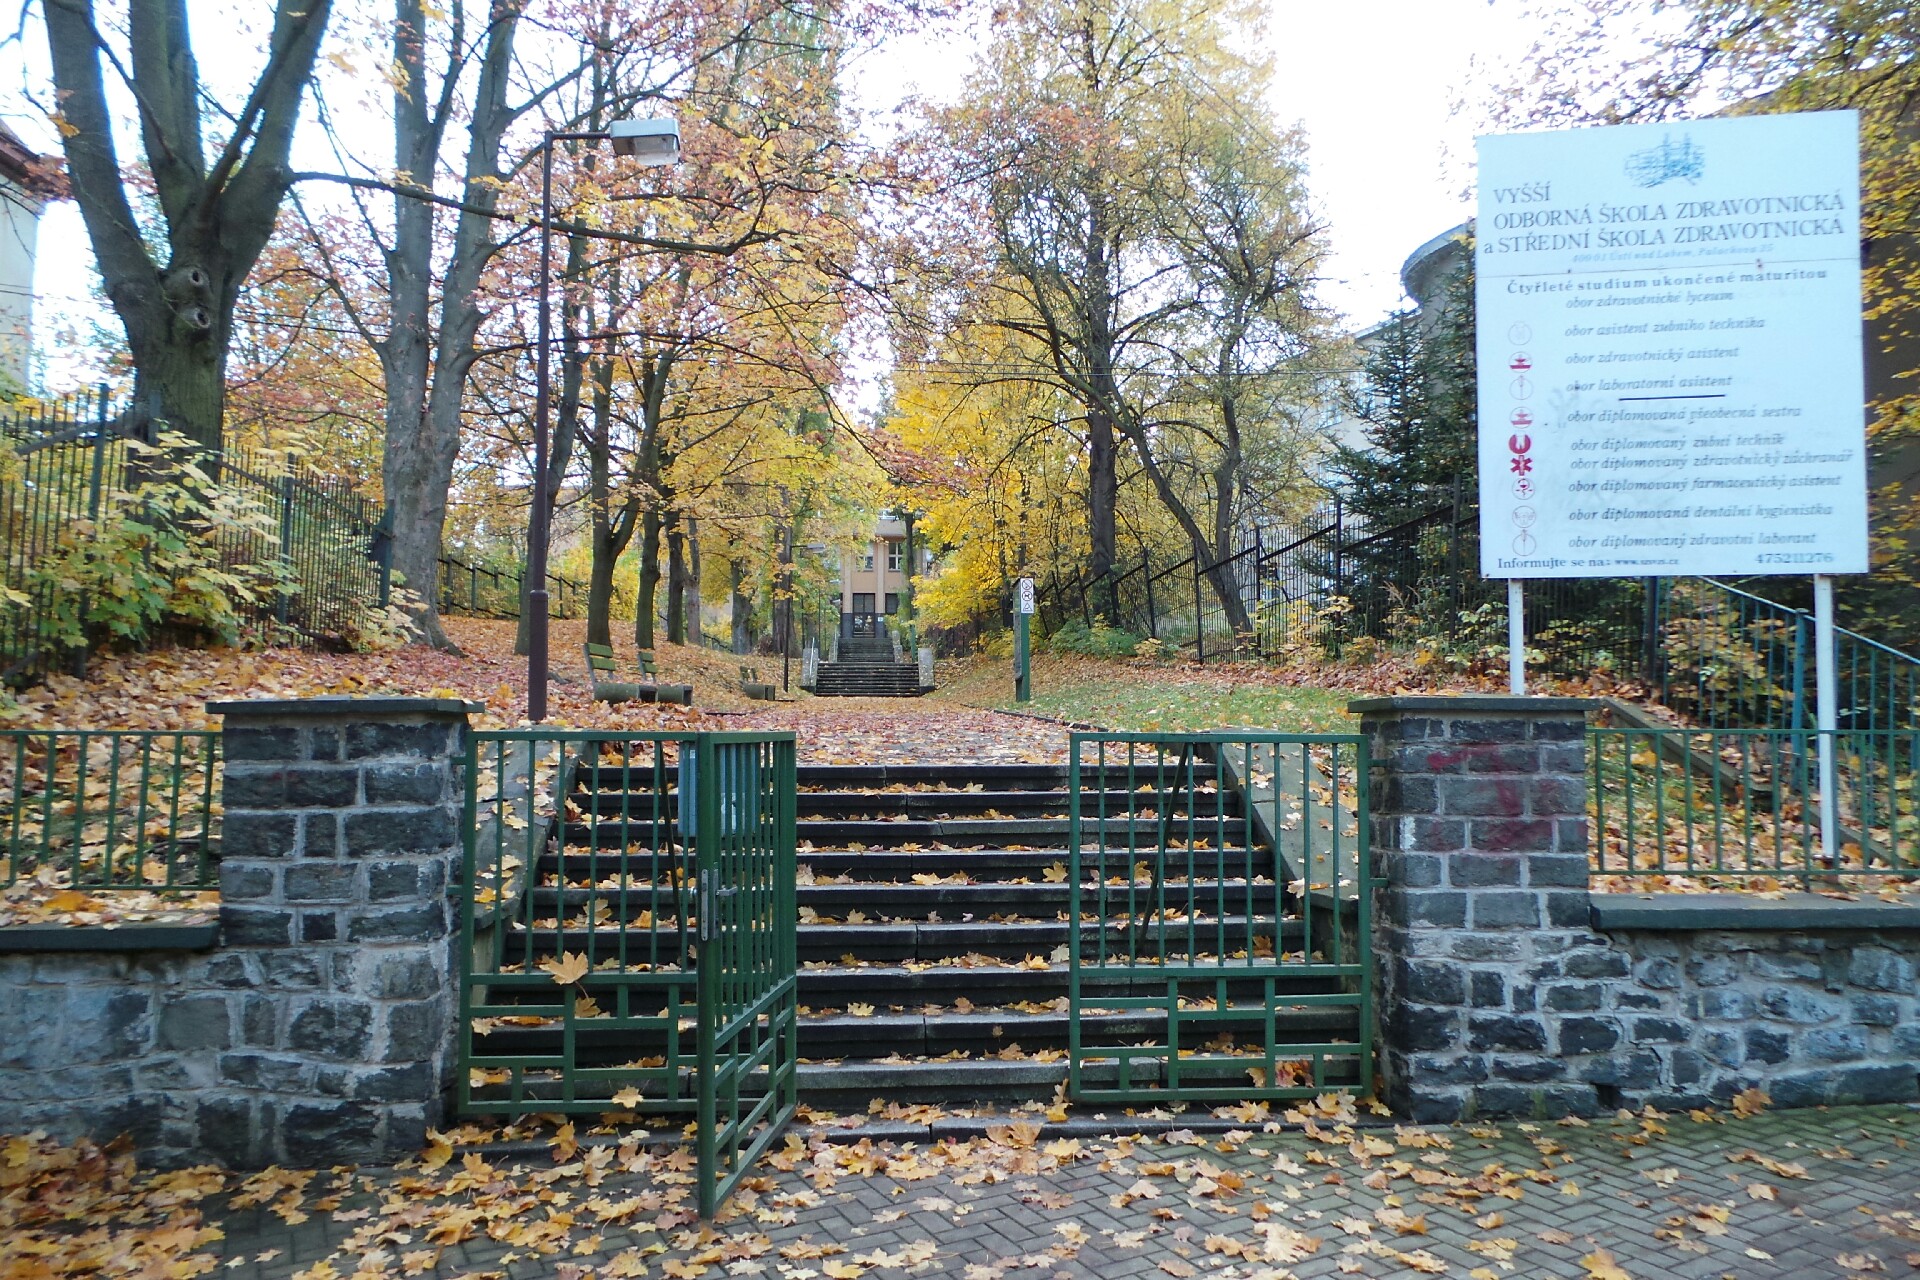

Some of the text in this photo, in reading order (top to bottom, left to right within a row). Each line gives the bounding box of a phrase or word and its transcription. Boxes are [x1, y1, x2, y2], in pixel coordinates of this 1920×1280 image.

[1493, 181, 1551, 204] VYŠŠÍ
[1493, 189, 1845, 230] ODBORNÁ ŠKOLA ZDRAVOTNICKÁ
[1483, 213, 1845, 254] a STŘEDNÍ ŠKOLA ZDRAVOTNICKÁ
[1507, 268, 1827, 295] Čtyřleté studium ukončené maturitou
[1566, 296, 1593, 308] obor
[1596, 291, 1682, 307] zdravotnické
[1685, 290, 1734, 306] lyceum
[1564, 325, 1593, 337] obor
[1596, 323, 1649, 336] asistent
[1709, 316, 1766, 330] technika
[1565, 346, 1740, 364] obor zdravotnický asistent
[1566, 375, 1733, 392] obor laboratorní asistent
[1567, 410, 1596, 422] obor
[1598, 407, 1688, 423] diplomovaná
[1761, 406, 1802, 418] sestra
[1571, 433, 1785, 452] obor diplomovaný zubní technik
[1570, 449, 1853, 471] obor diplomovaný zdravotnický záchranář
[1568, 475, 1842, 495] obor diplomovaný farmaceutický asistent
[1569, 503, 1833, 522] obor diplomovaná dentální hygienistka
[1568, 531, 1817, 549] obor diplomovaný zdravotní laborant
[1497, 557, 1567, 570] Informujte
[1571, 558, 1585, 567] se
[1589, 558, 1611, 567] na:
[1755, 552, 1834, 564] 475211276
